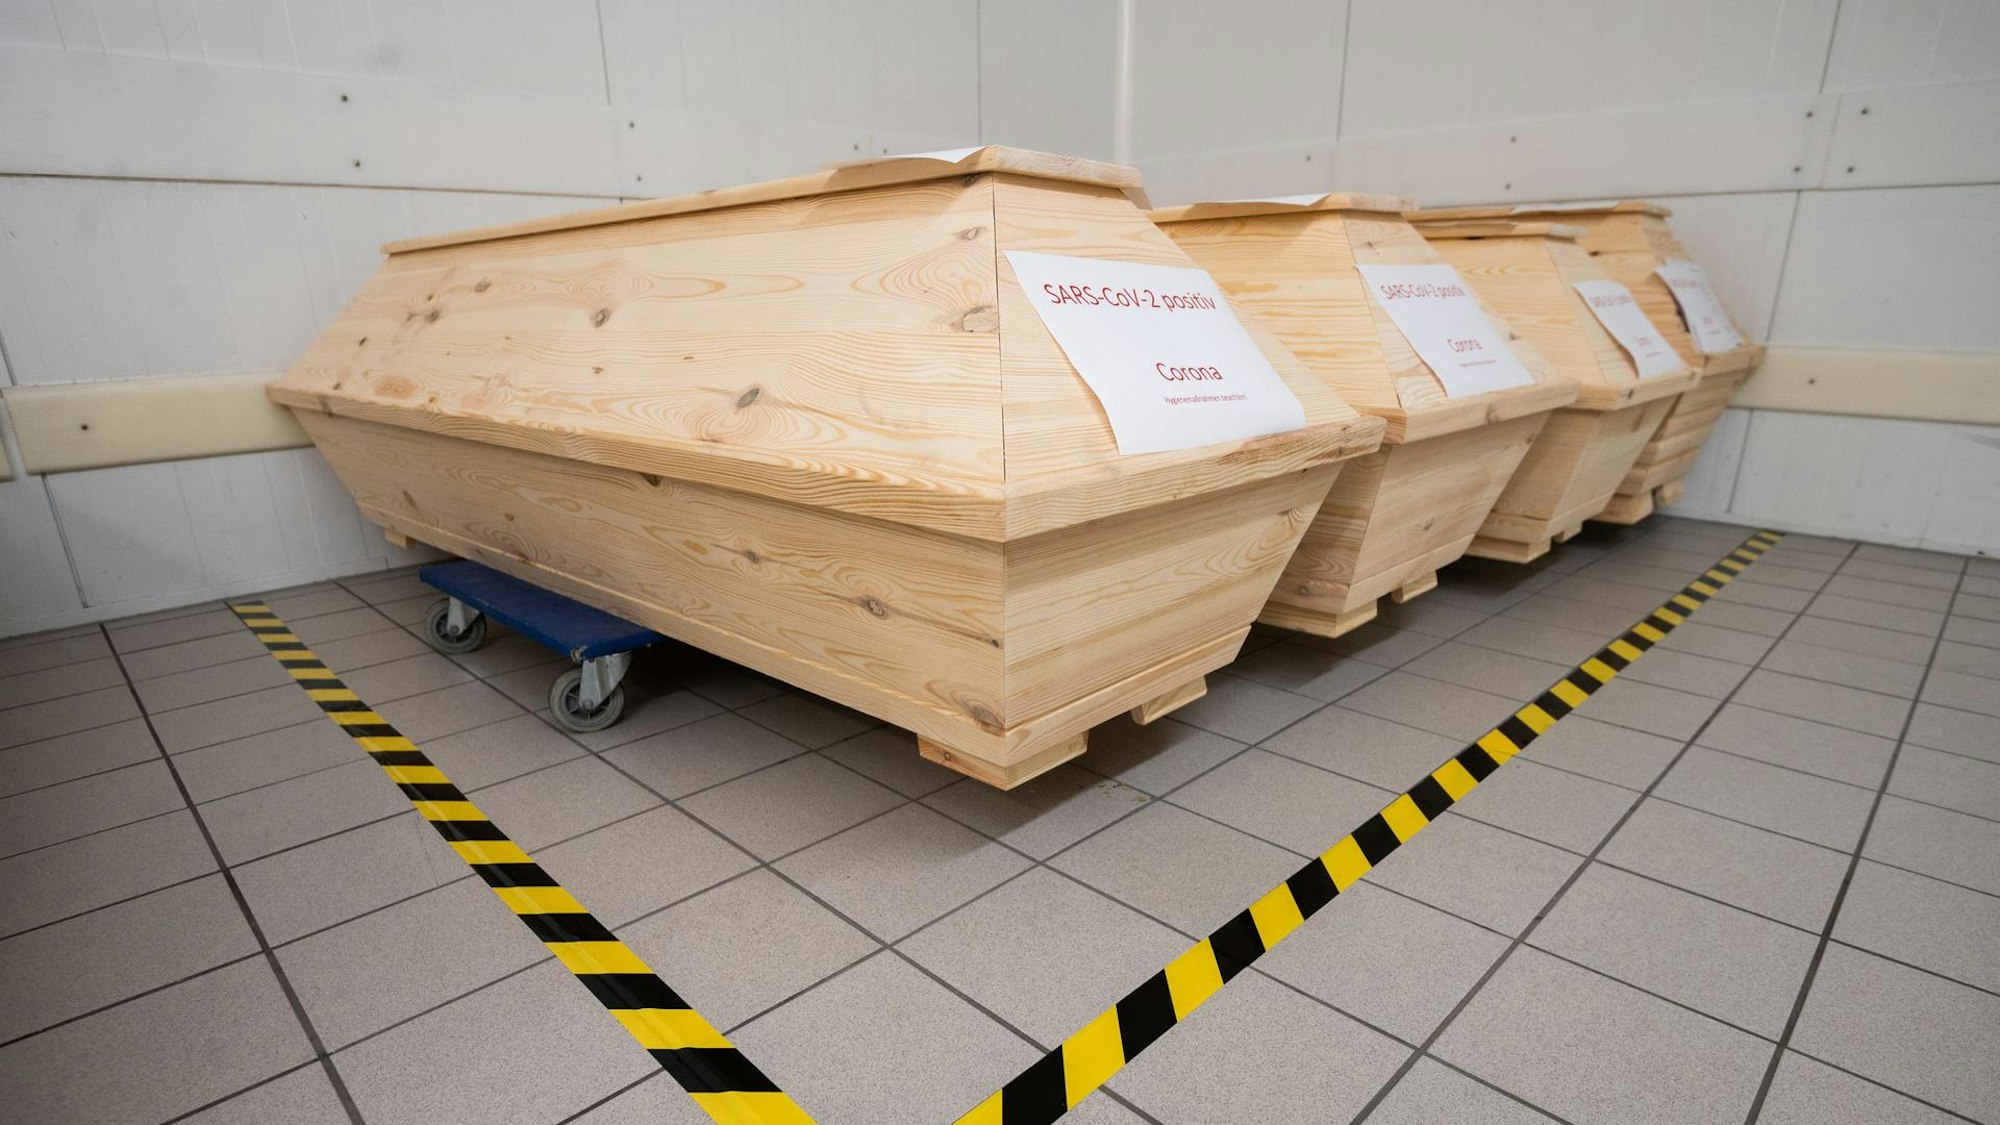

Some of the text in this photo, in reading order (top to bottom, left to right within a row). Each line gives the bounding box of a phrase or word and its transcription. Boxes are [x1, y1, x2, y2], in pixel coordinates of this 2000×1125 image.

[1043, 283, 1217, 313] SARS-CoV-2 positiv
[1447, 338, 1484, 353] Corona
[1155, 362, 1224, 382] Corona
